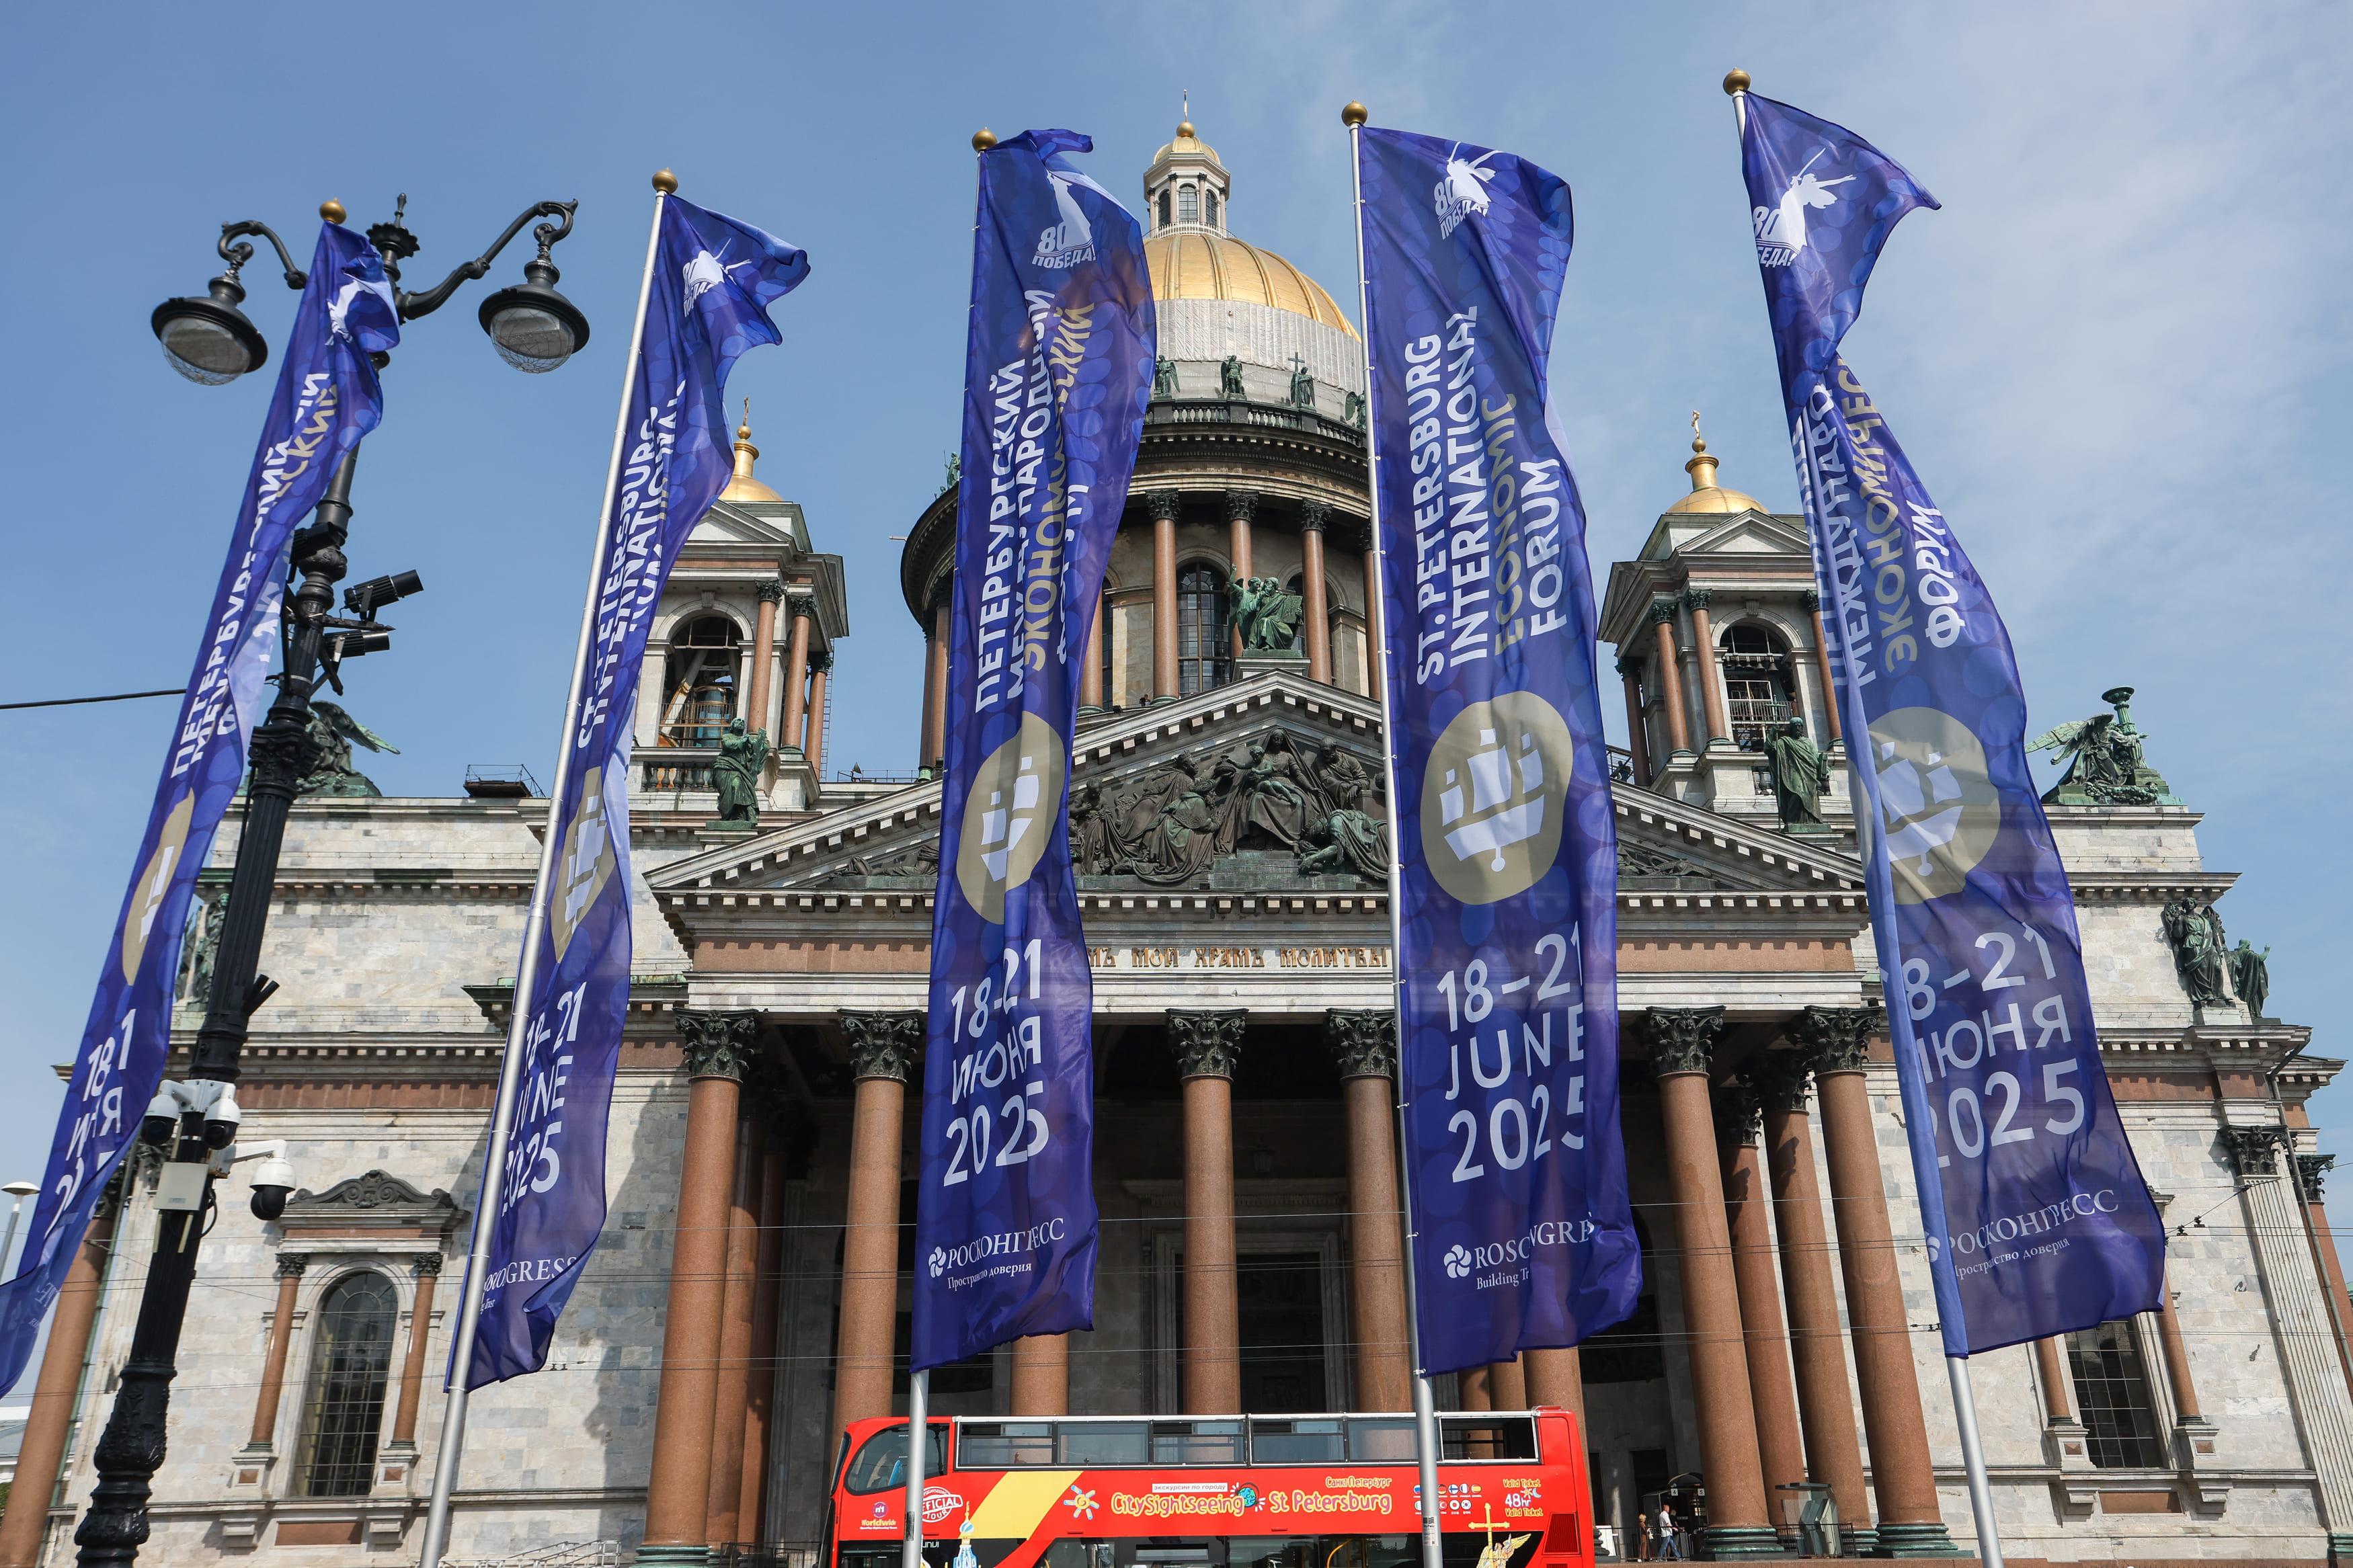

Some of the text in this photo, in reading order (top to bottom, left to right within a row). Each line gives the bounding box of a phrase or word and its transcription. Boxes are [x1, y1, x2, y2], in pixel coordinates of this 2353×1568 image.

[1037, 221, 1067, 253] 80
[1434, 176, 1455, 216] 80
[1031, 243, 1096, 269] ПОБЕДА!
[1405, 334, 1447, 686] ST. PETERSBURG
[1446, 306, 1490, 667] INTERNATIONAL
[1482, 394, 1524, 656] ECONOMIC
[1837, 358, 1918, 673] ЭКОНОМИЧЕС
[975, 359, 1026, 714] ПЕТЕРБУРГСКИЙ
[1520, 458, 1568, 636] FORUM
[1906, 499, 1966, 649] ФОРУМ
[951, 939, 1041, 1044] 18-21
[1437, 920, 1583, 1032] 18-21
[1880, 921, 2057, 1021] 8-21
[952, 1016, 1041, 1105] ИЮНЯ
[1445, 1002, 1584, 1100] JUNE
[944, 1081, 1049, 1187] 2025
[988, 1263, 1032, 1281] доверия
[1476, 1272, 1519, 1290] Building
[2023, 1237, 2071, 1261] доверия
[926, 1509, 948, 1520] TOUR
[1111, 1491, 1245, 1518] CitySightseeing
[1269, 1489, 1392, 1515] St Petersburg
[1503, 1478, 1542, 1488] Valid Ticket
[1505, 1493, 1531, 1508] 48hr
[1505, 1508, 1544, 1517] Valid Ticket
